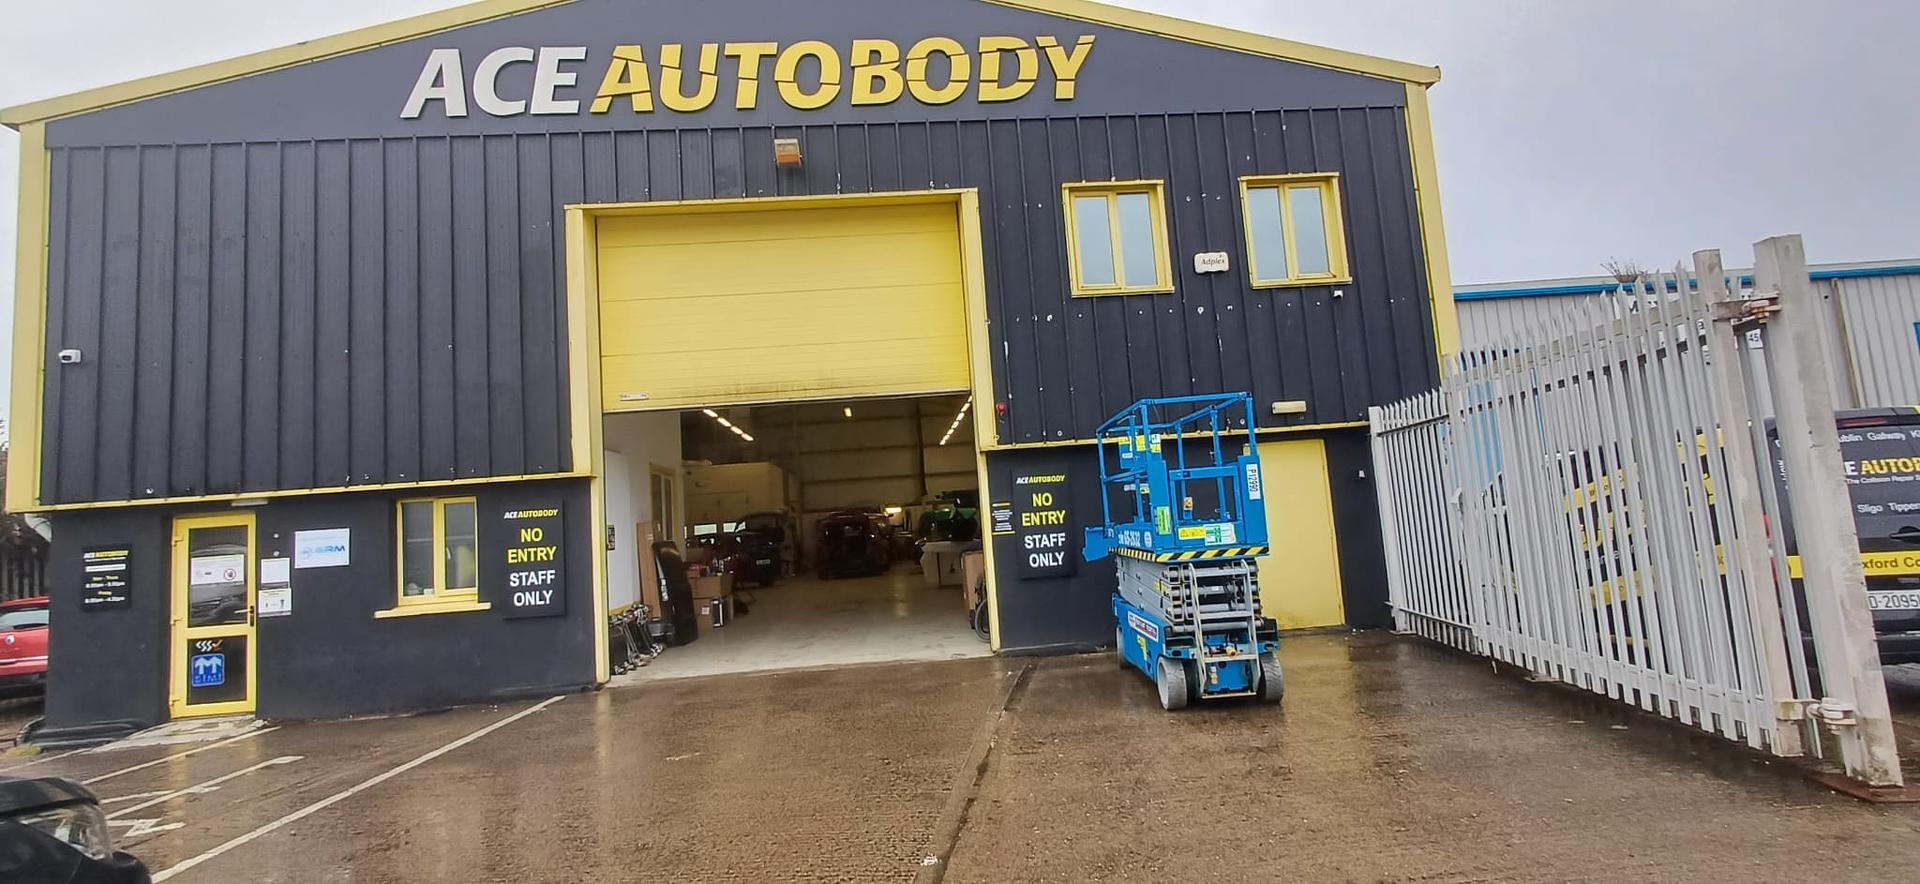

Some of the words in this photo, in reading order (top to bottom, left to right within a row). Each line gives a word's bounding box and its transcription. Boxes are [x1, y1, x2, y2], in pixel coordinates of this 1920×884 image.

[400, 45, 588, 119] ACE
[589, 34, 1096, 113] AUTOBODY
[1016, 476, 1029, 485] ACE
[1028, 475, 1066, 484] AUTOBODY
[1032, 492, 1053, 507] NO
[504, 510, 518, 520] ACE
[517, 508, 559, 519] AUTOBODY
[1857, 503, 1884, 514] Sligo
[1021, 510, 1066, 527] ENTRY
[520, 527, 543, 543] NO
[1024, 532, 1066, 549] STAFF
[507, 546, 557, 564] ENTRY
[1028, 551, 1065, 568] ONLY
[1862, 557, 1899, 569] xford
[509, 569, 556, 587] STAFF
[513, 589, 554, 607] ONLY
